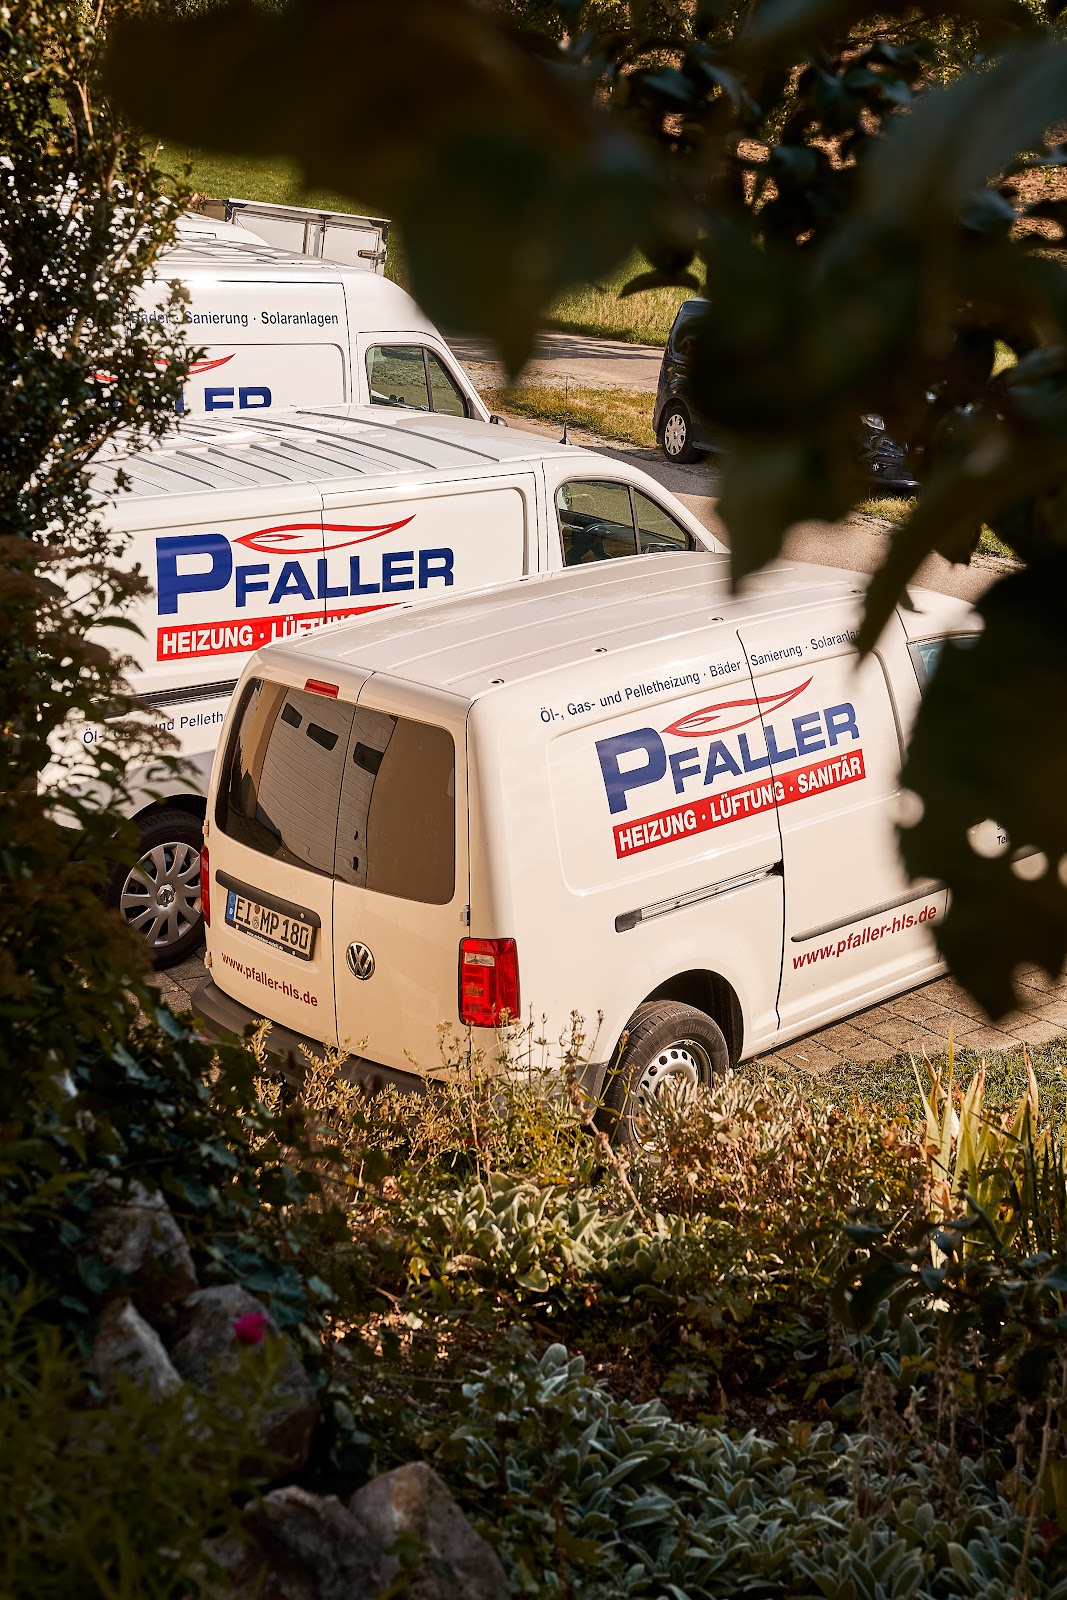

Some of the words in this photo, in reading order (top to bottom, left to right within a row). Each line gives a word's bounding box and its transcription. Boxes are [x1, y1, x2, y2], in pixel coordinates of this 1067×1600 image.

[185, 311, 248, 327] Sanierung
[261, 311, 339, 327] Solaranlagen
[155, 533, 454, 615] PFALLER
[162, 625, 253, 655] HEIZUNG
[540, 707, 565, 723] Öl-,
[567, 701, 596, 716] Gas-
[599, 691, 623, 708] und
[626, 672, 701, 700] Pelletheizung
[709, 659, 742, 677] Bäder
[750, 644, 803, 667] Sanierung
[180, 711, 226, 728] Pelleth
[594, 702, 860, 815] PFALLER
[618, 809, 698, 852] HEIZUNG
[709, 780, 786, 823] LÜFTUNG
[797, 755, 862, 794] SANITÄR
[236, 897, 251, 925] EI
[260, 911, 279, 935] MP
[280, 919, 309, 950] 180
[792, 905, 937, 970] www.pfaller-hls.de
[221, 952, 318, 1007] www.pfaller-hls.de
